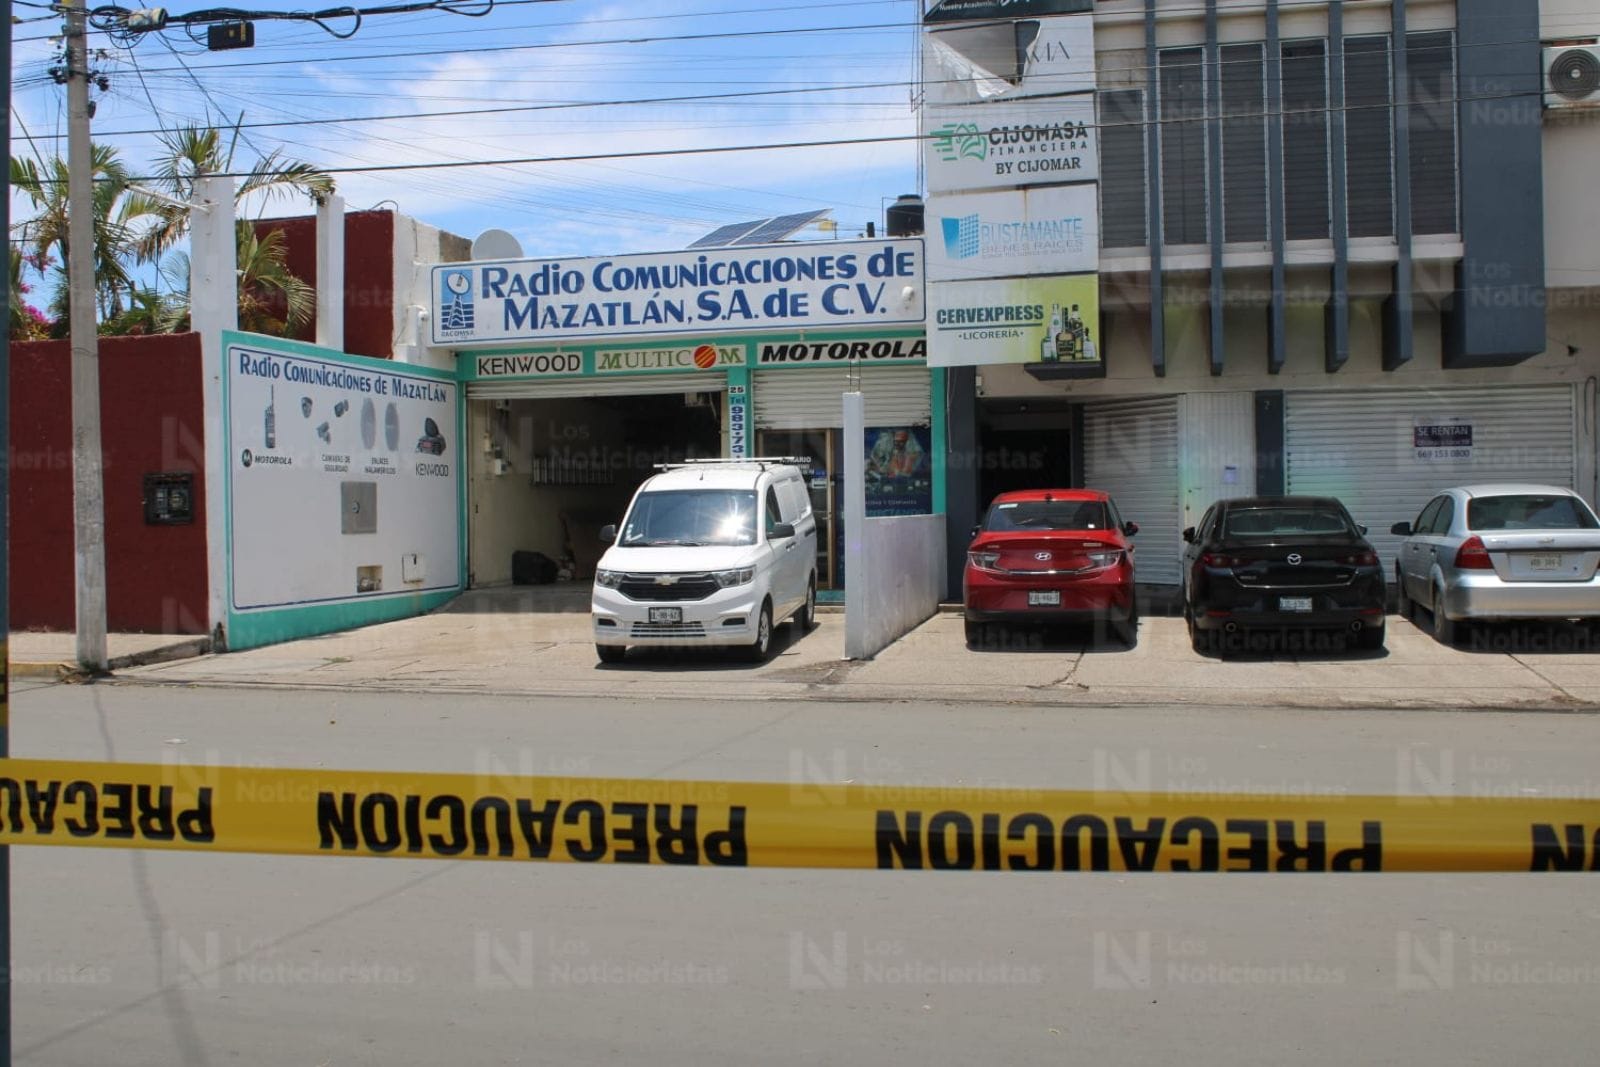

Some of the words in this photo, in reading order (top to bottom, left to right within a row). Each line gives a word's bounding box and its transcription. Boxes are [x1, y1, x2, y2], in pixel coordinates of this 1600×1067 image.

[990, 141, 1088, 157] FINANCIERA
[996, 161, 1013, 175] BY
[1017, 156, 1081, 173] CIJOMAR
[936, 304, 1044, 324] CERVEXPRESS
[761, 337, 926, 362] MOTOROLA
[477, 354, 581, 376] KENWOOD
[254, 455, 292, 465] MOTOROLA
[415, 464, 449, 477] KENWOOD
[317, 791, 747, 867] PRECAUCION
[875, 810, 1382, 873] PRECAUCION
